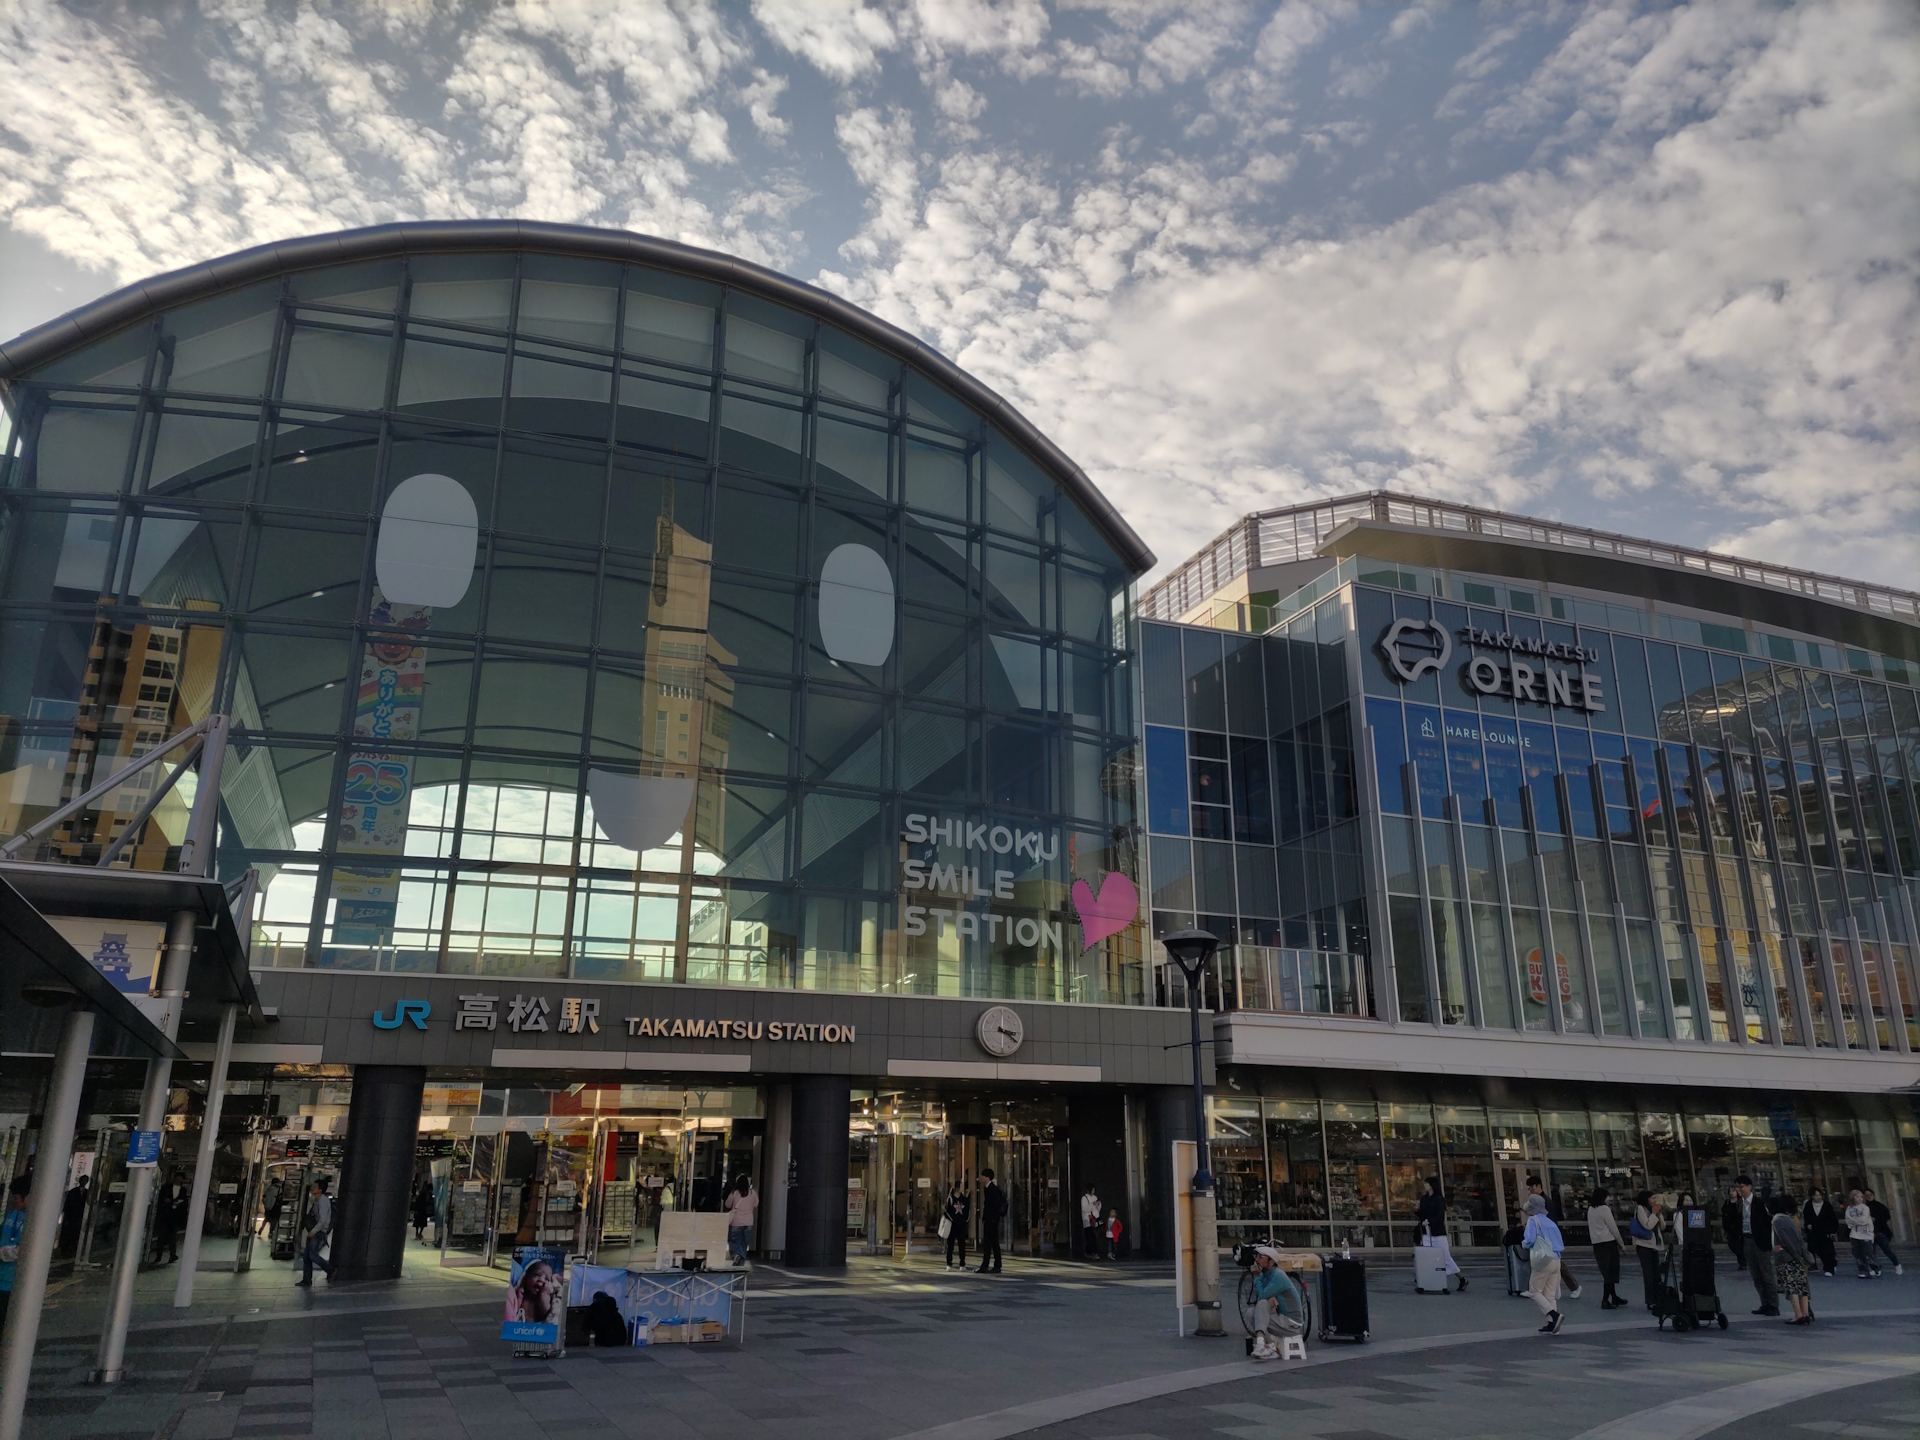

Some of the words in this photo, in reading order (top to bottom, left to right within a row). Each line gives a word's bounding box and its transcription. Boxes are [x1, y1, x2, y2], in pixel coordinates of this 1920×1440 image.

[1464, 625, 1600, 663] TAKAMATSU
[1469, 656, 1606, 712] ORNE
[1446, 725, 1478, 740] HARE
[345, 761, 407, 805] 25
[361, 807, 377, 833] 周年
[905, 813, 1059, 861] SHIKOKU
[368, 887, 382, 895] JR
[903, 858, 1015, 899] SMILE
[904, 906, 1063, 950] STATION
[1529, 963, 1569, 978] BUER
[1531, 975, 1571, 994] KIG
[373, 1000, 431, 1030] JR
[455, 993, 601, 1034] 高松駅
[625, 1016, 763, 1040] TAKAMATSU
[768, 1021, 856, 1043] STATION
[1691, 1212, 1703, 1220] JW
[513, 1326, 536, 1336] unicef
